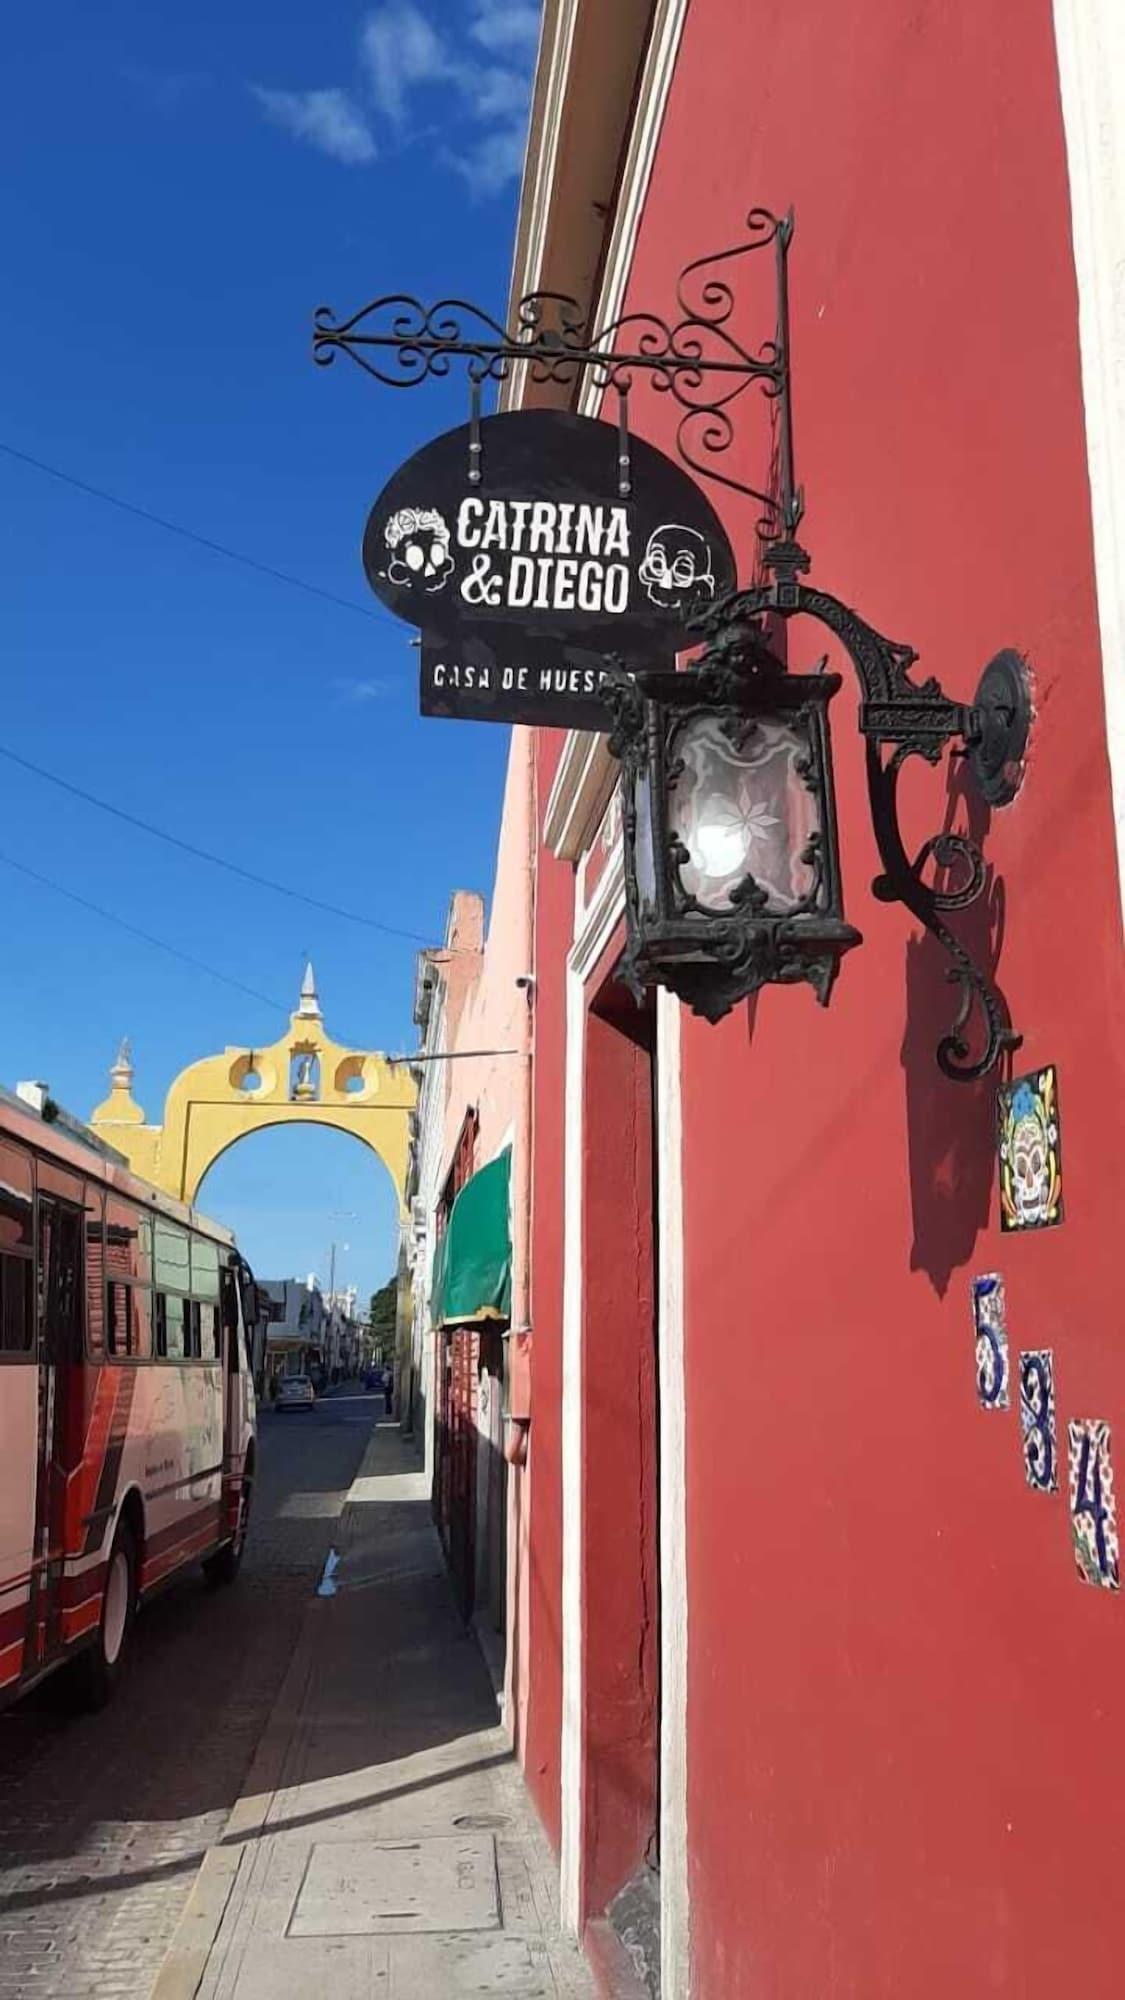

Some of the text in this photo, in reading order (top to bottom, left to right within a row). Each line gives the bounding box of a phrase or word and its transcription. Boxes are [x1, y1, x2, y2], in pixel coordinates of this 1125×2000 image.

[457, 497, 631, 557] CATRINA
[507, 556, 630, 614] DIEGO
[433, 664, 490, 688] CASA
[502, 667, 529, 691] DE
